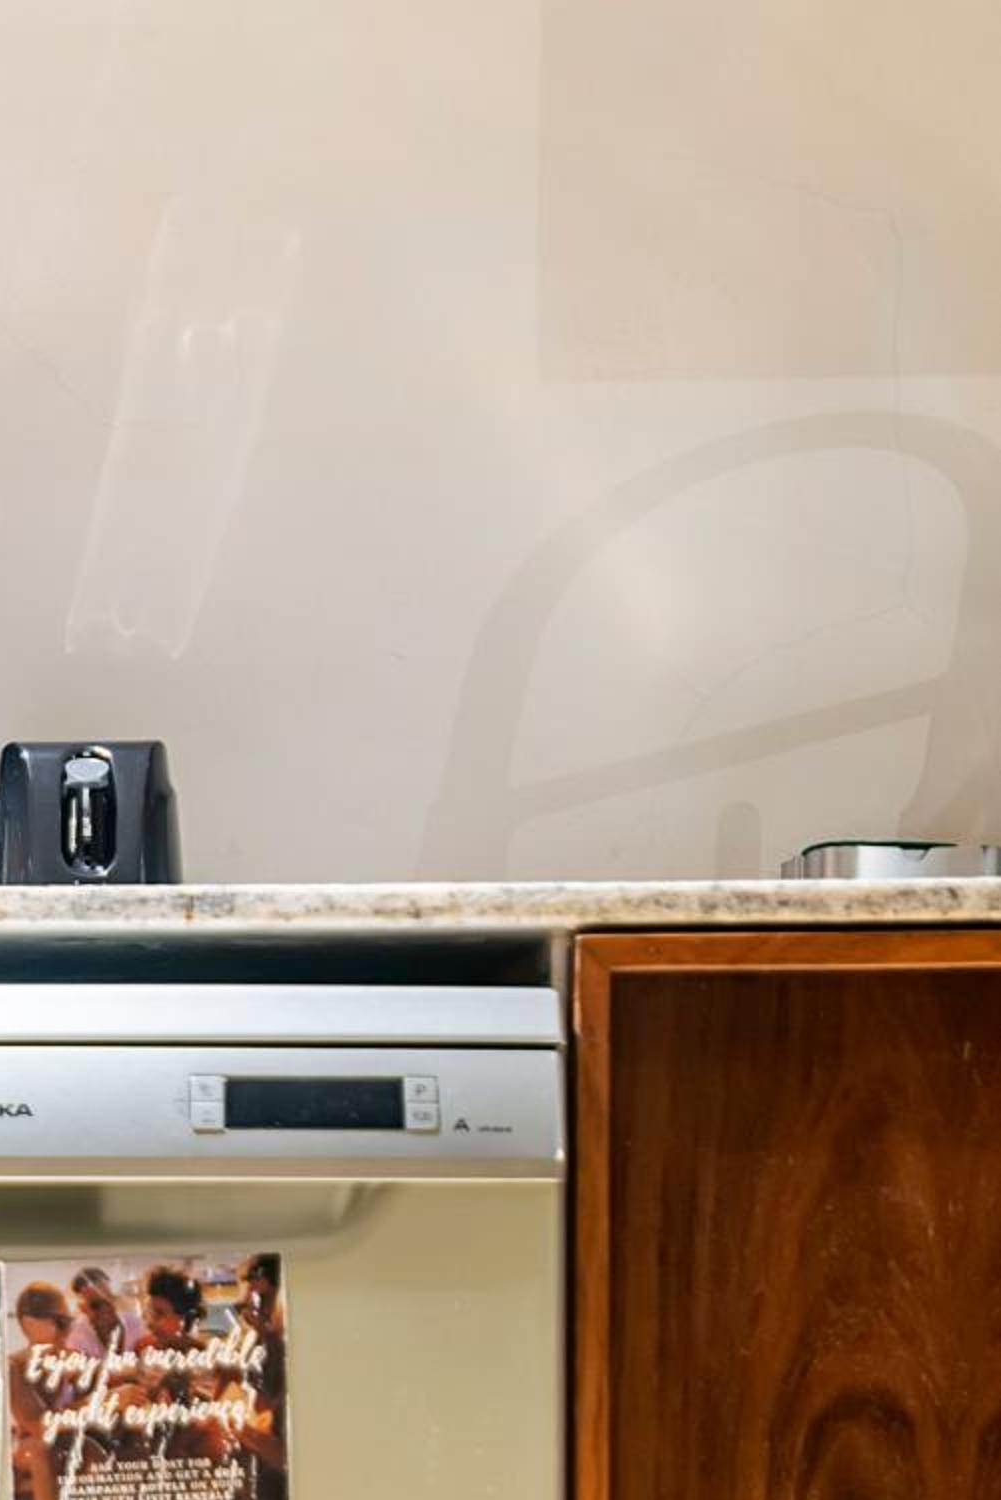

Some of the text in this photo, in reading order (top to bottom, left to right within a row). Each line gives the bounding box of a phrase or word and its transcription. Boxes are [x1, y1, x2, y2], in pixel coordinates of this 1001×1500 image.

[25, 1344, 100, 1389] Enjoy
[142, 1327, 266, 1373] incredible
[117, 1460, 149, 1470] YOUR
[188, 1458, 211, 1468] FOR
[58, 1472, 143, 1484] INORMATION
[176, 1469, 199, 1480] GET
[202, 1469, 212, 1479] A
[60, 1485, 135, 1496] AMPAGNE
